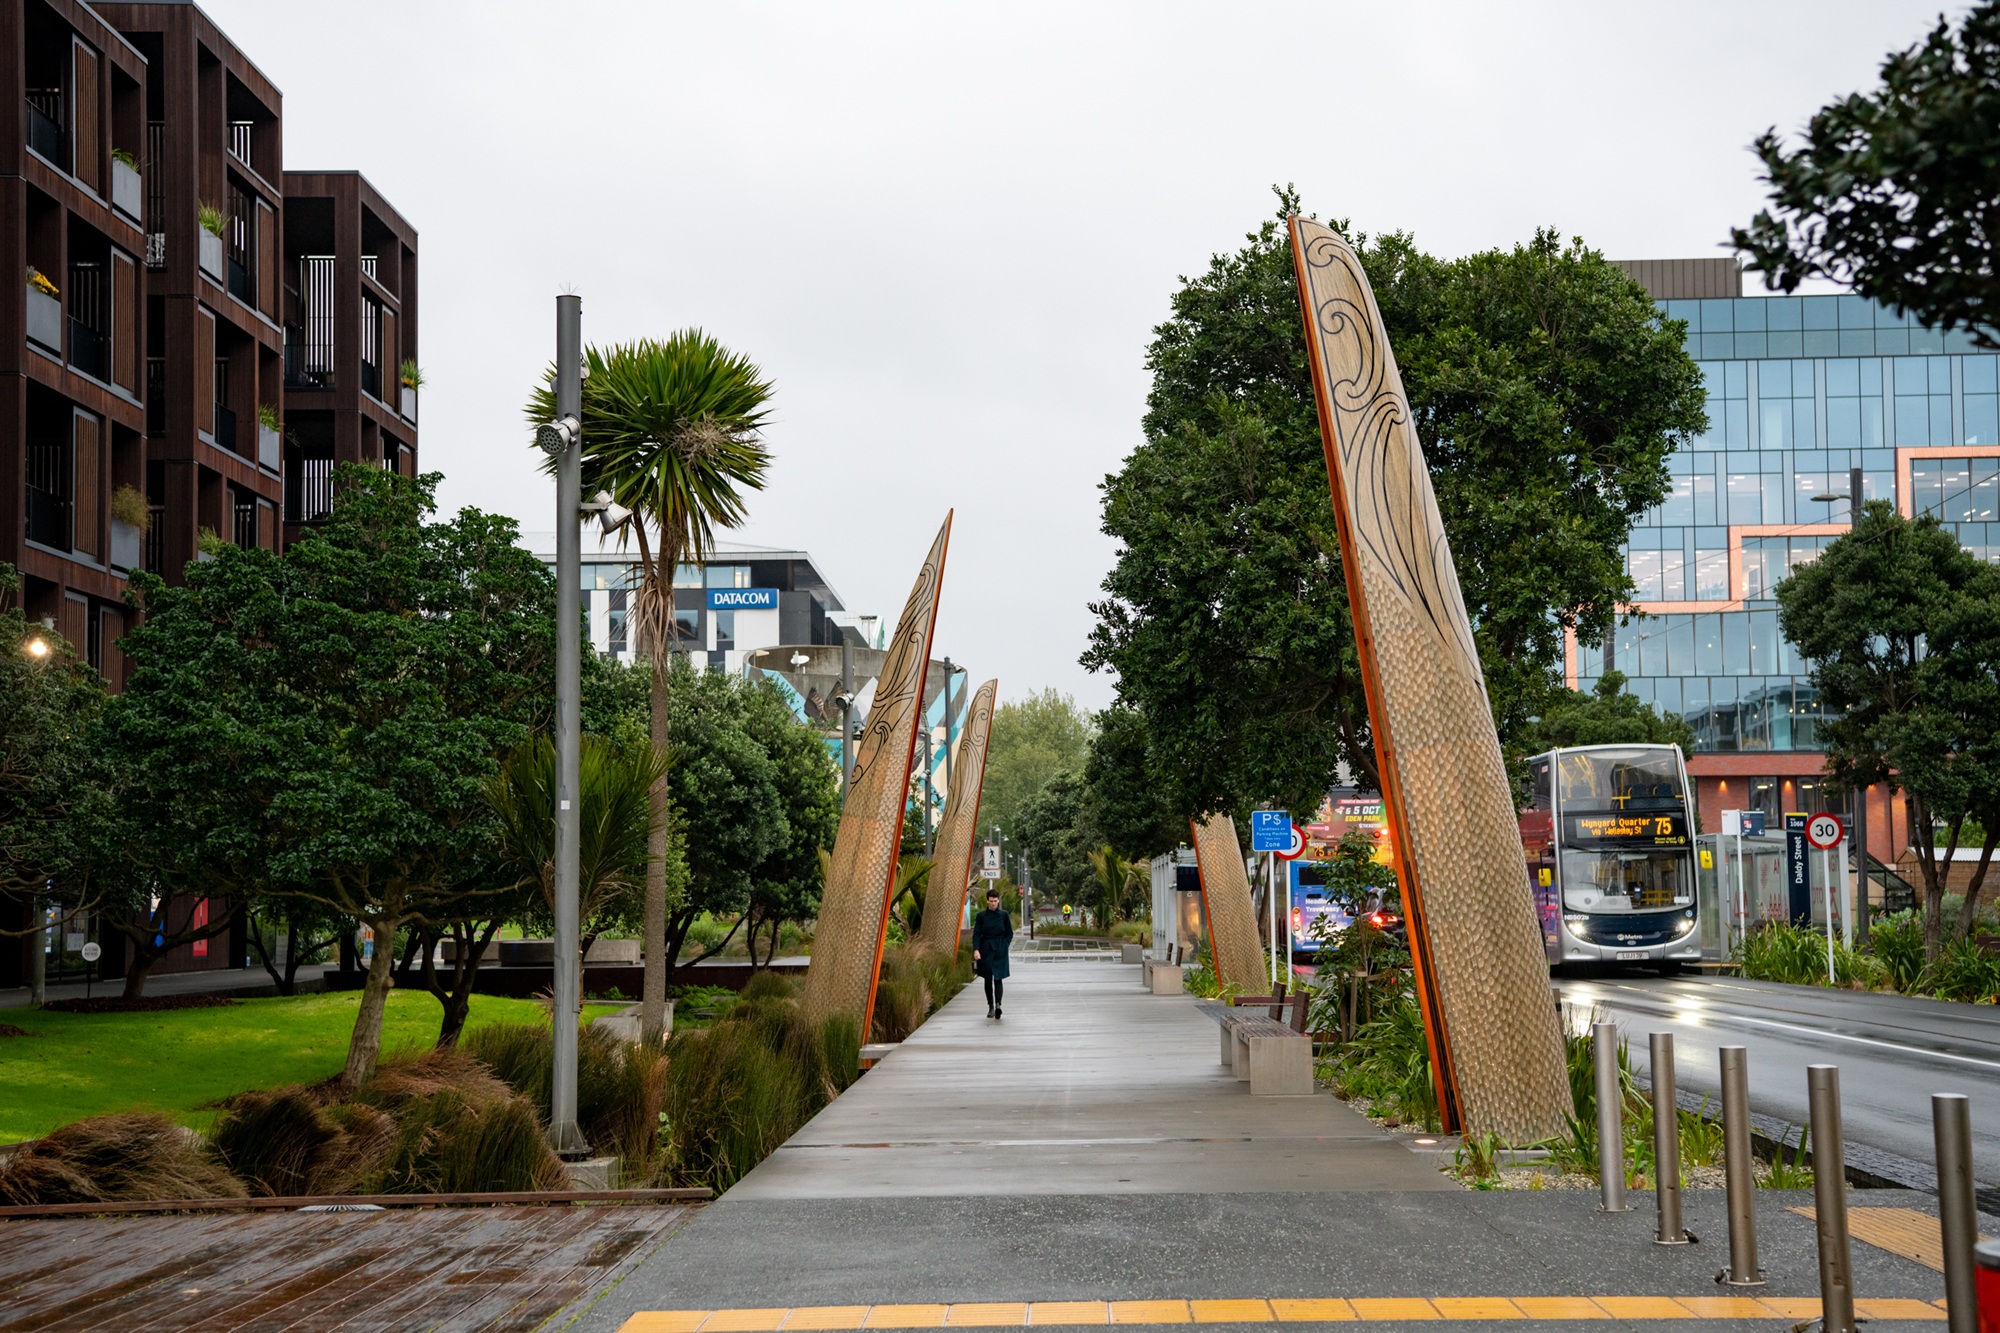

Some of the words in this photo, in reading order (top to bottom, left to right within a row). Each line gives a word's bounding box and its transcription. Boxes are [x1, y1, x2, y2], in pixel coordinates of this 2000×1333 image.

[714, 592, 770, 605] DATACOM
[1354, 805, 1360, 814] 5
[1362, 805, 1381, 814] OCT
[1581, 819, 1616, 829] Wynyard
[1618, 818, 1650, 827] Quarter
[1635, 826, 1642, 834] St
[1654, 817, 1672, 835] 75
[1815, 824, 1835, 837] 30
[1314, 846, 1325, 857] 75
[1794, 836, 1802, 860] Street
[1795, 862, 1804, 884] Daldy
